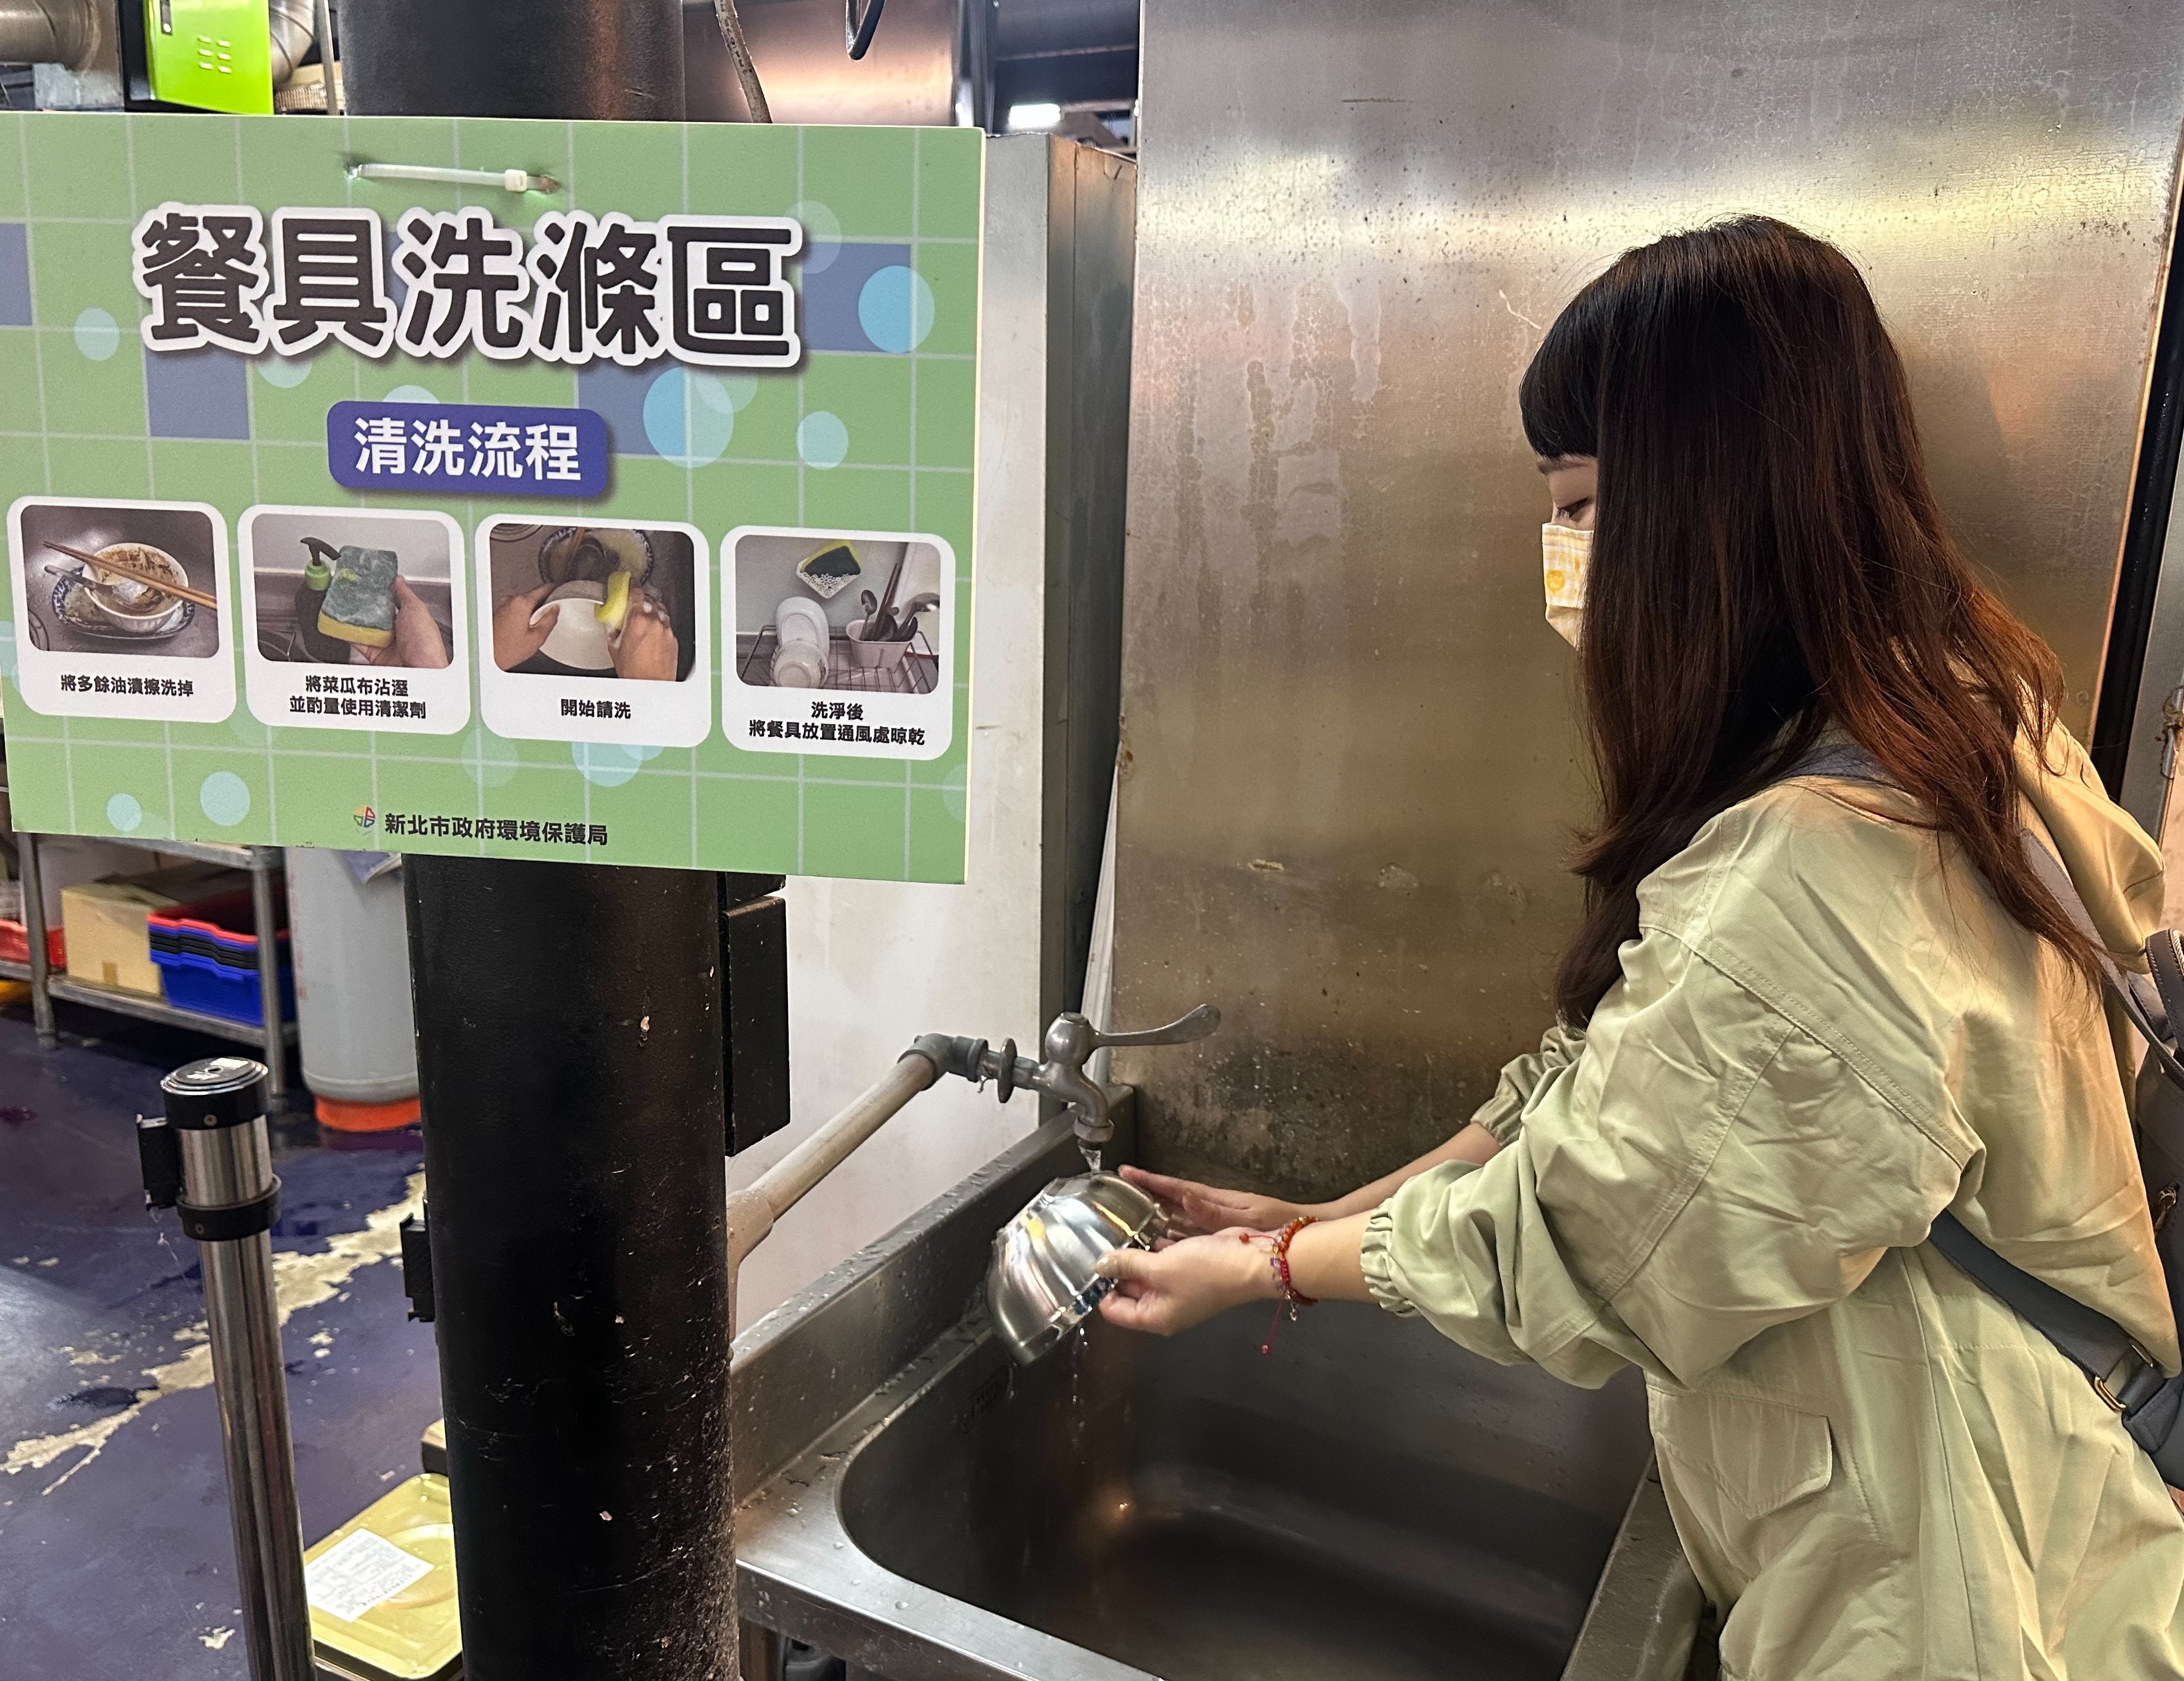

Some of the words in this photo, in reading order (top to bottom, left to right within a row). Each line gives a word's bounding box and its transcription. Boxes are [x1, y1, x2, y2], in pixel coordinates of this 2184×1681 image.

[141, 210, 792, 357] 餐具洗滌區
[352, 416, 581, 482] 清洗流程
[60, 674, 194, 697] 將多餘油漬擦洗掉
[305, 674, 409, 697] 將菜瓜布沾溼
[289, 695, 426, 719] 並酌量使用清潔劑
[560, 698, 632, 719] 開始請洗
[810, 700, 864, 721] 洗淨後
[748, 719, 926, 746] 將餐具放置通風處晾乾
[384, 812, 609, 846] 新北市政府環境保護局
